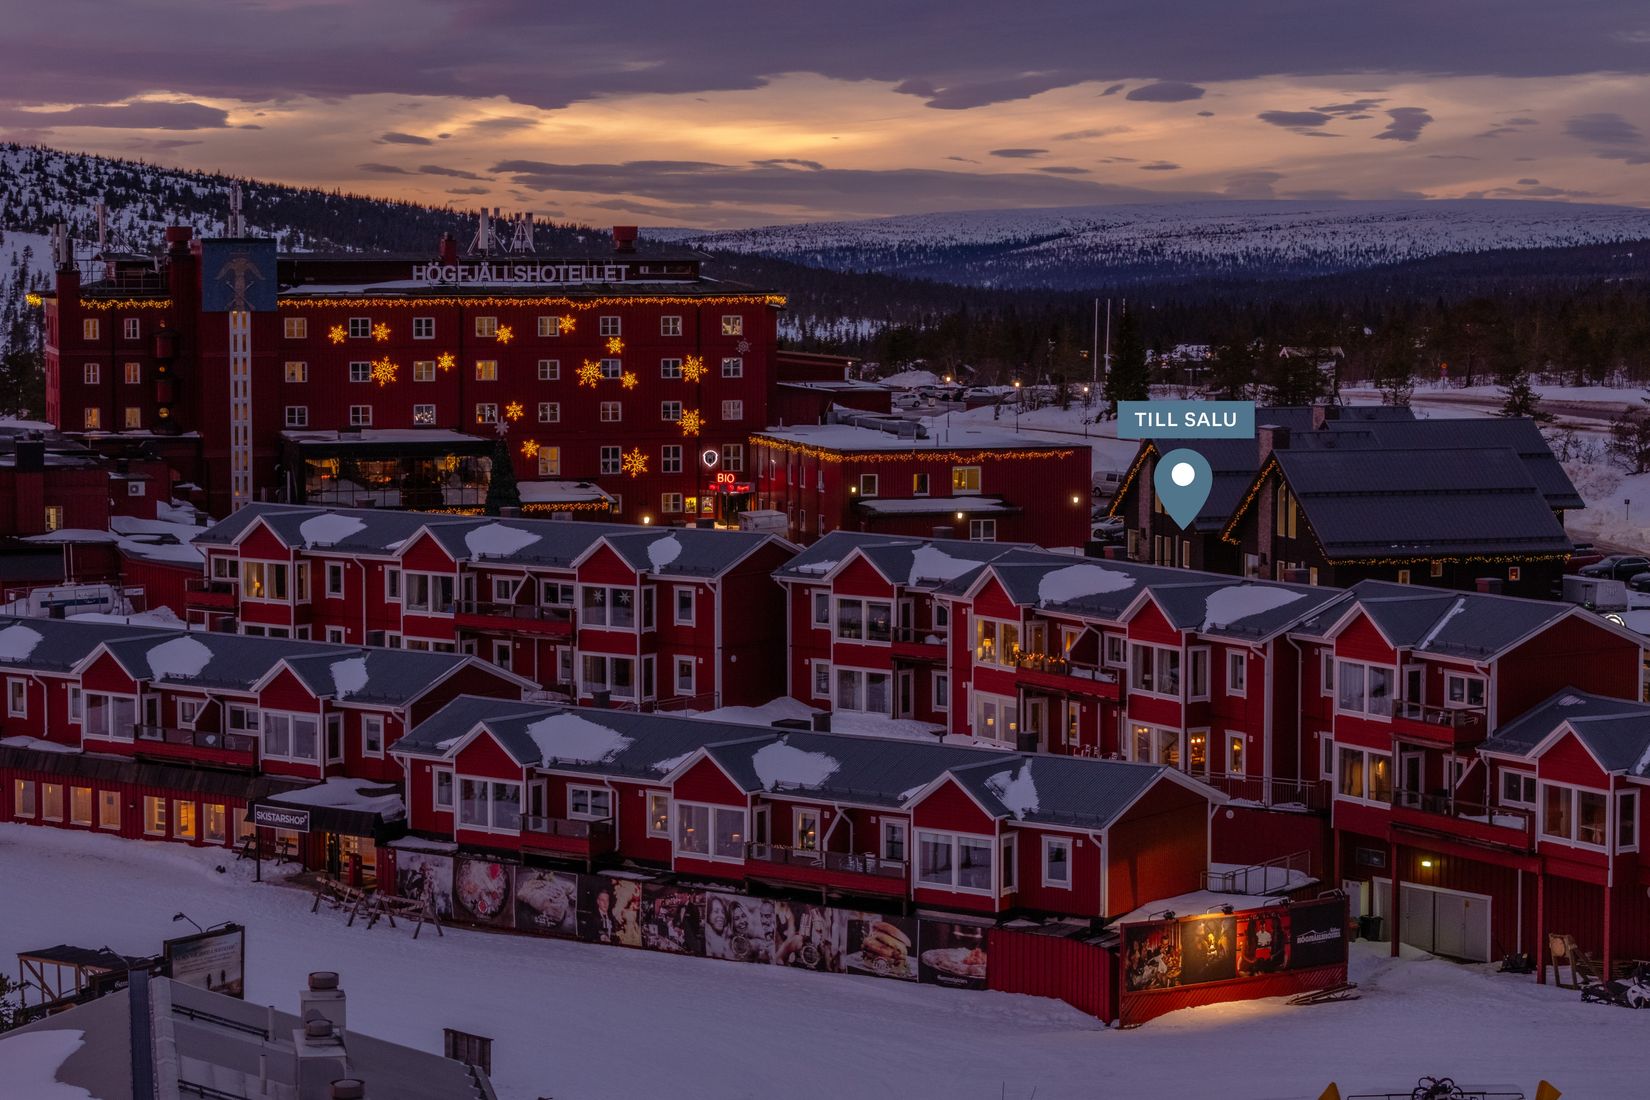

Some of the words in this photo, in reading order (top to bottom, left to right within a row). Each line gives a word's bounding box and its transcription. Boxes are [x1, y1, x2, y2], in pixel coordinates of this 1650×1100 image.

[412, 262, 630, 283] HÖGFJÄLLSHOTELLET
[717, 473, 735, 483] BIO
[256, 811, 305, 825] SKISTARSHOP
